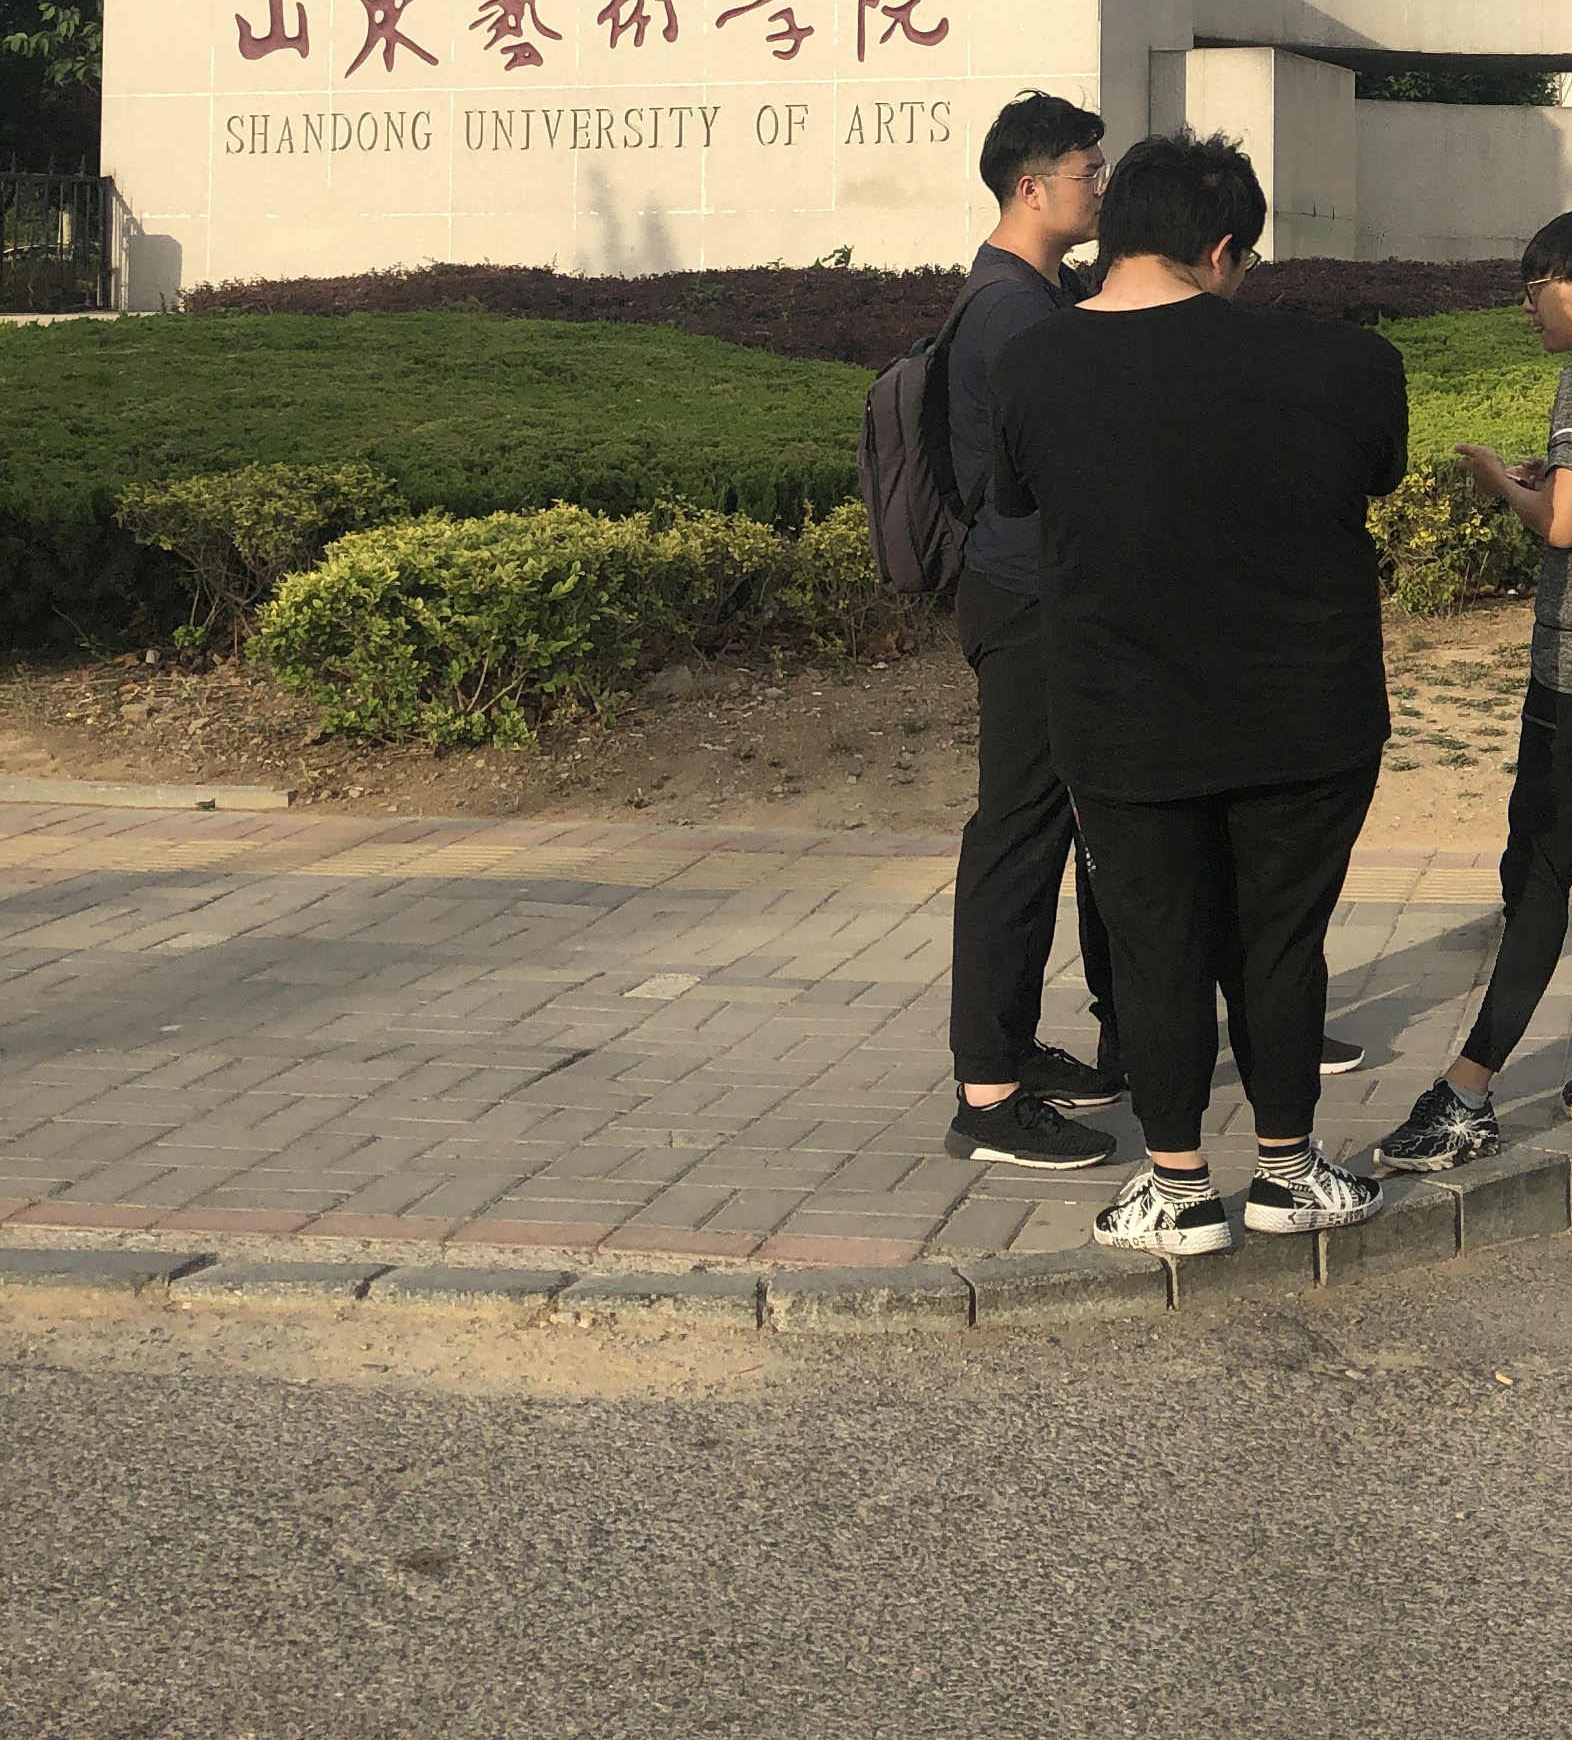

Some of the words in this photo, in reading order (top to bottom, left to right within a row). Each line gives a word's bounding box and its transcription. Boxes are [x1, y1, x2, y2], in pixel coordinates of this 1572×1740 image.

[226, 110, 433, 156] SHANDONG
[465, 105, 723, 153] UNIVERSITY
[757, 105, 809, 147] OF
[845, 101, 952, 145] ARTS
